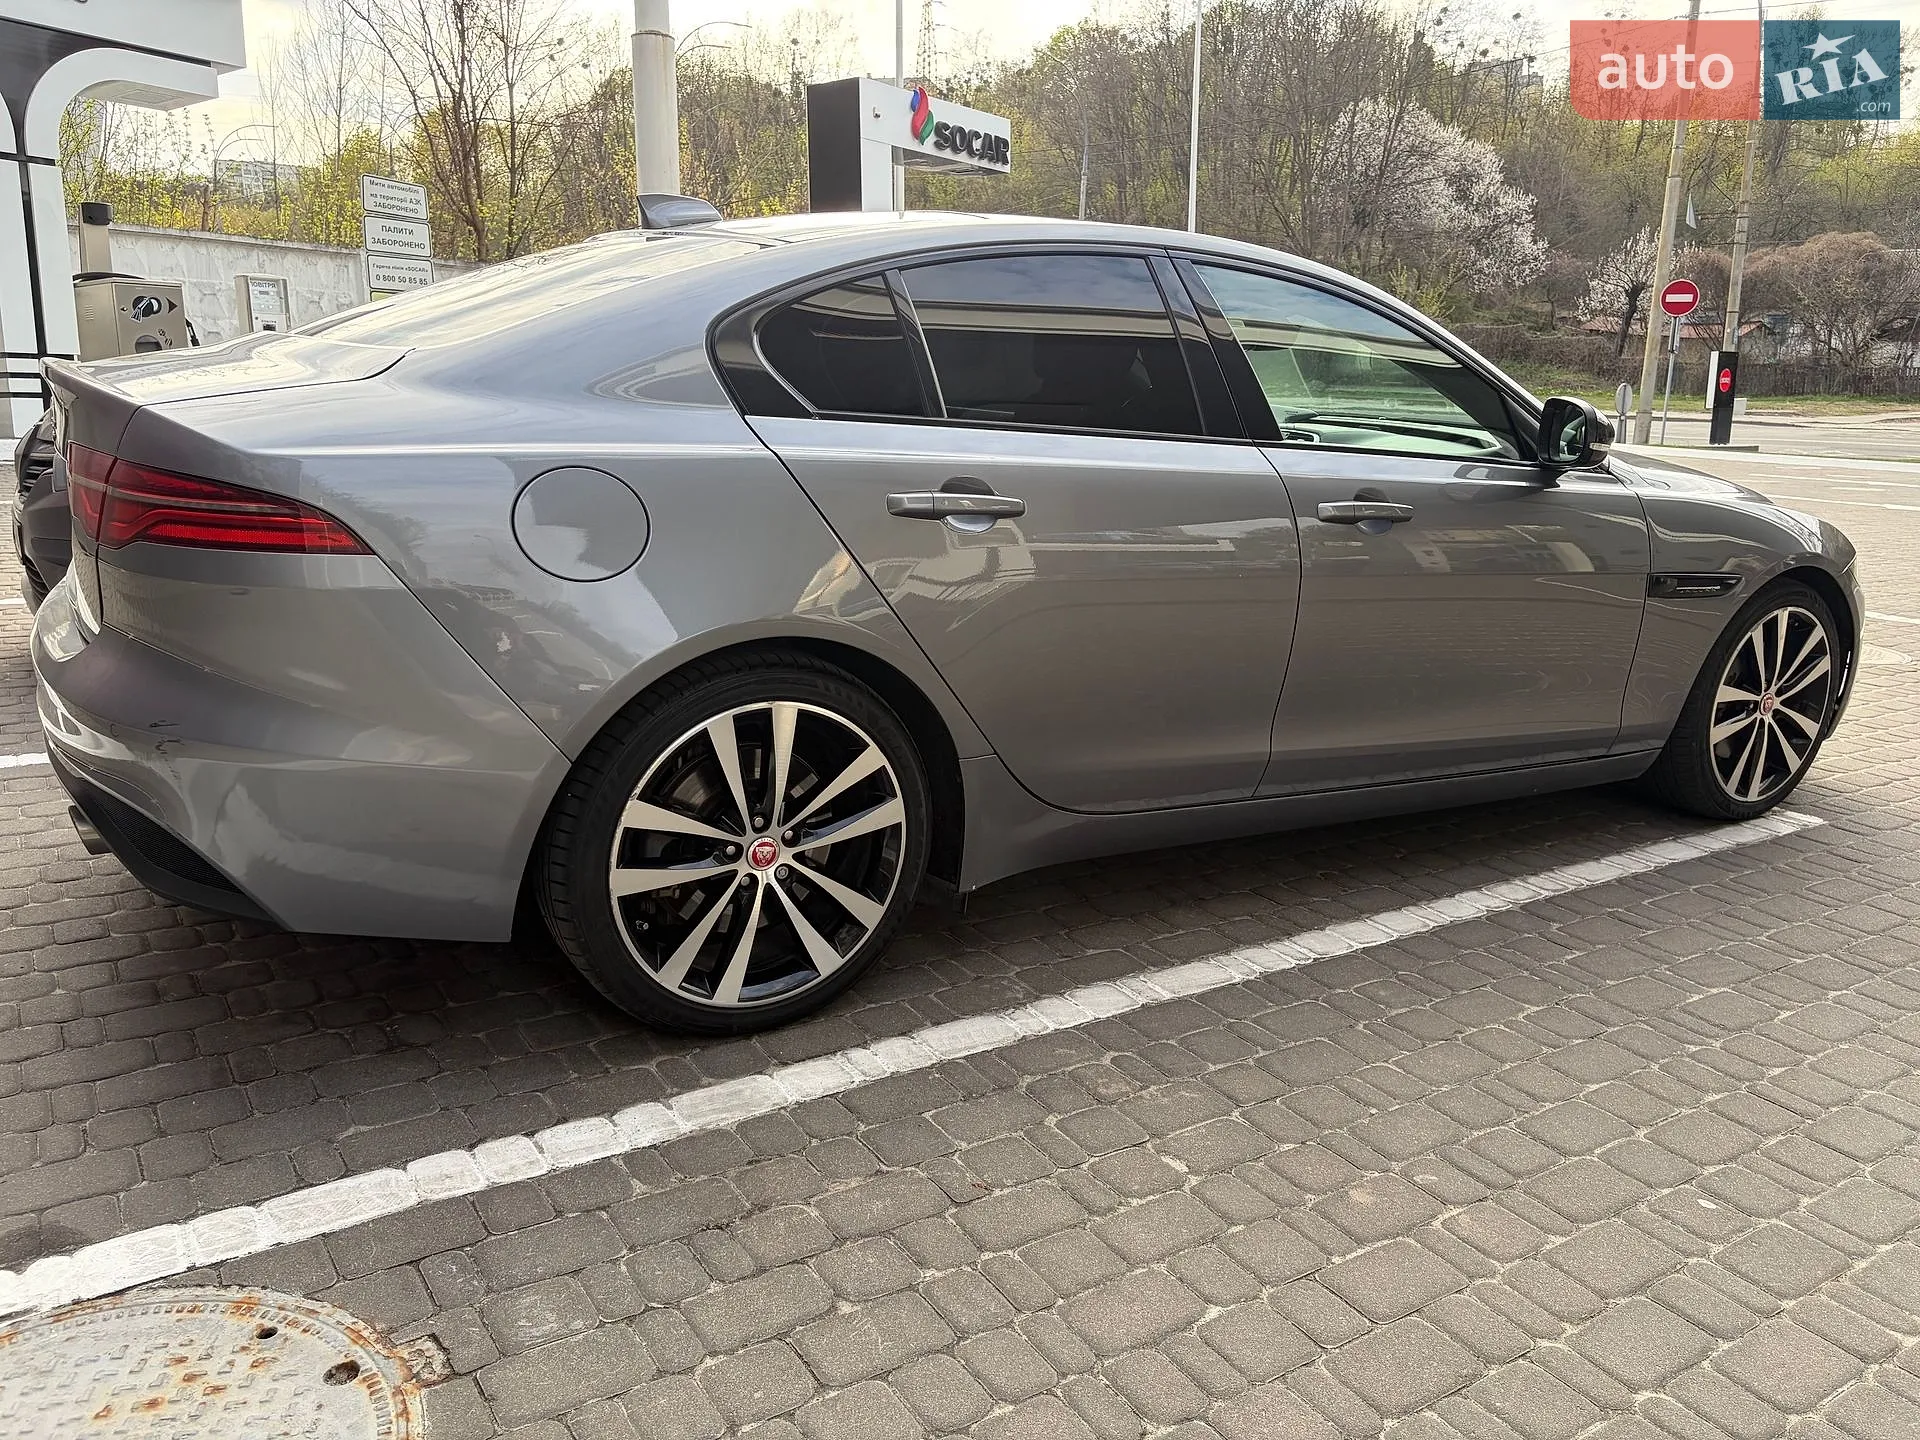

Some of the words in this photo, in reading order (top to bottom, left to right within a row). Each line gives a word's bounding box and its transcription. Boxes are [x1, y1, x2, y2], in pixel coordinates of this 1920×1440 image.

[934, 120, 1010, 166] SOCAR
[369, 179, 386, 188] Мити
[373, 201, 419, 214] ЗАБОРОНЕНО
[410, 197, 423, 206] АЗК
[381, 225, 414, 236] ПАЛИТИ
[371, 237, 426, 249] ЗАБОРОНЕНО
[375, 273, 381, 281] 0
[382, 274, 396, 282] 800
[397, 275, 407, 283] 50
[418, 278, 428, 286] 85
